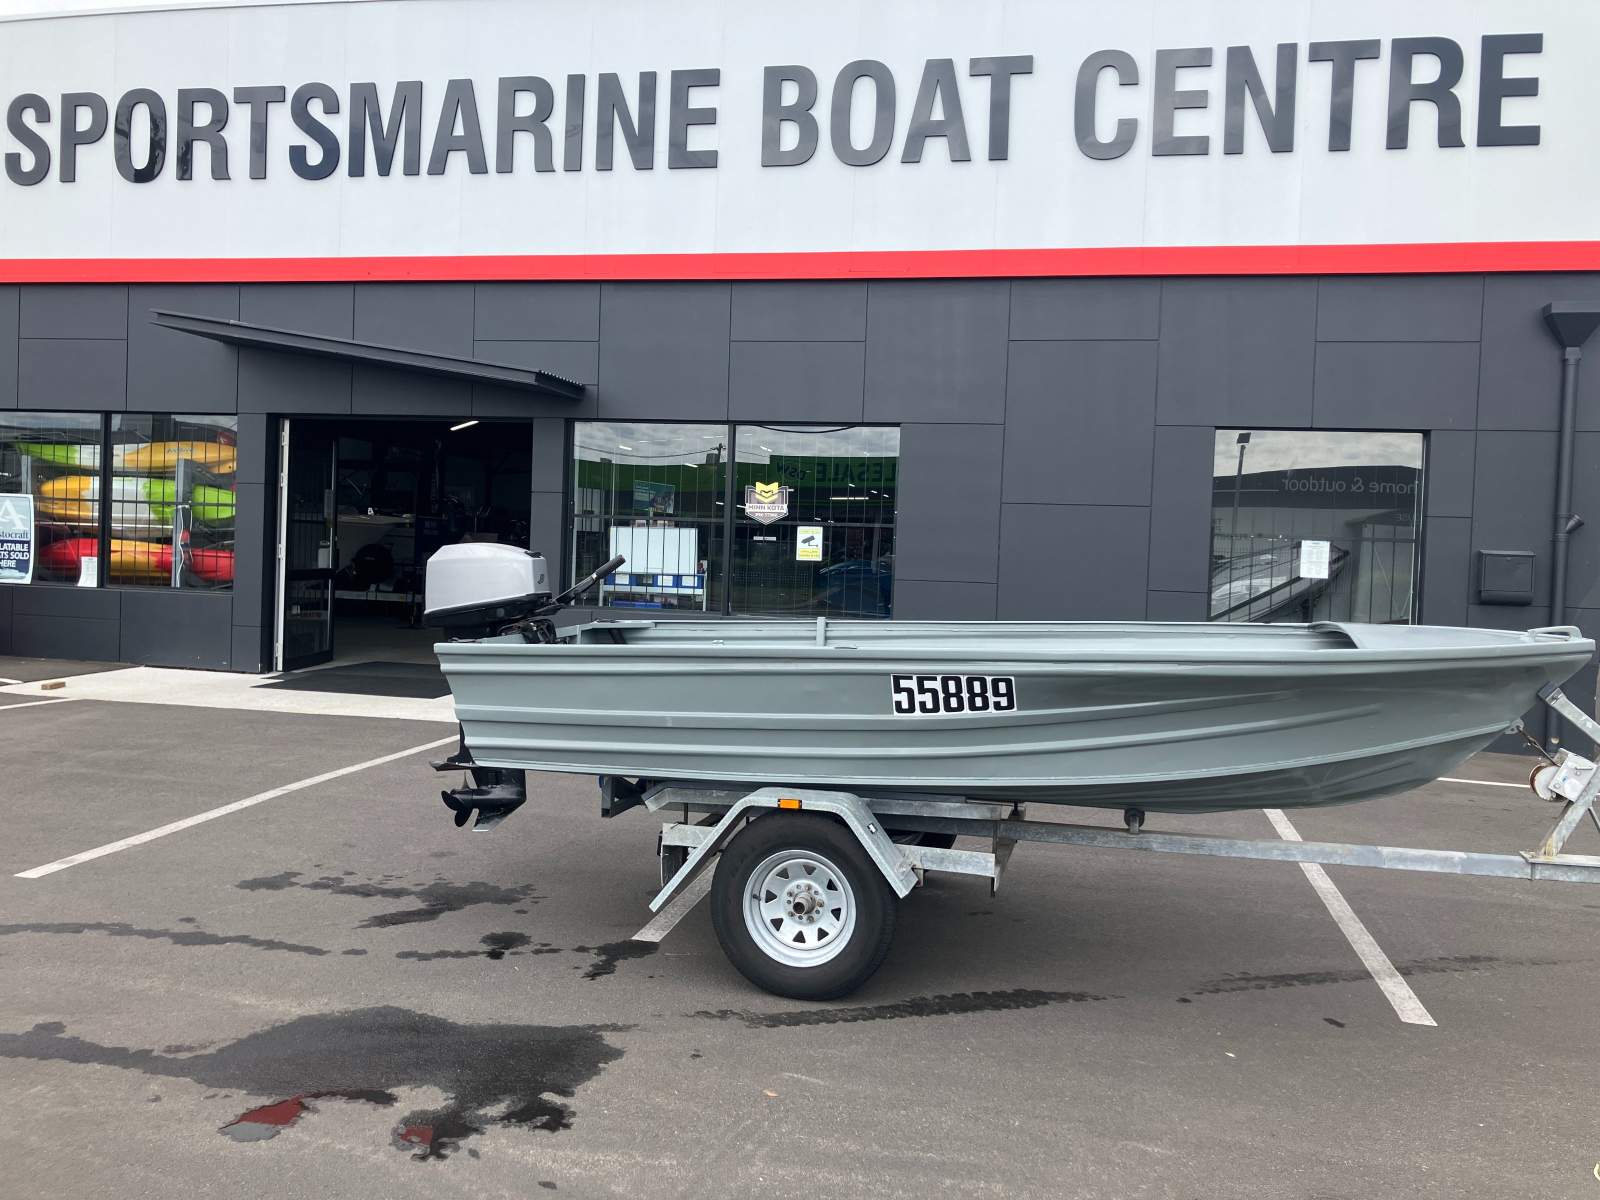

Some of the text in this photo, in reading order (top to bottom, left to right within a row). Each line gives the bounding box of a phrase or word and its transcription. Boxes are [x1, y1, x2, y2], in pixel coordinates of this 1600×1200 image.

[4, 32, 1544, 186] SPORTSMARINE BOAT CENTRE
[0, 530, 29, 539] tocraft
[10, 551, 29, 560] SOLD
[892, 675, 1015, 714] 55889
